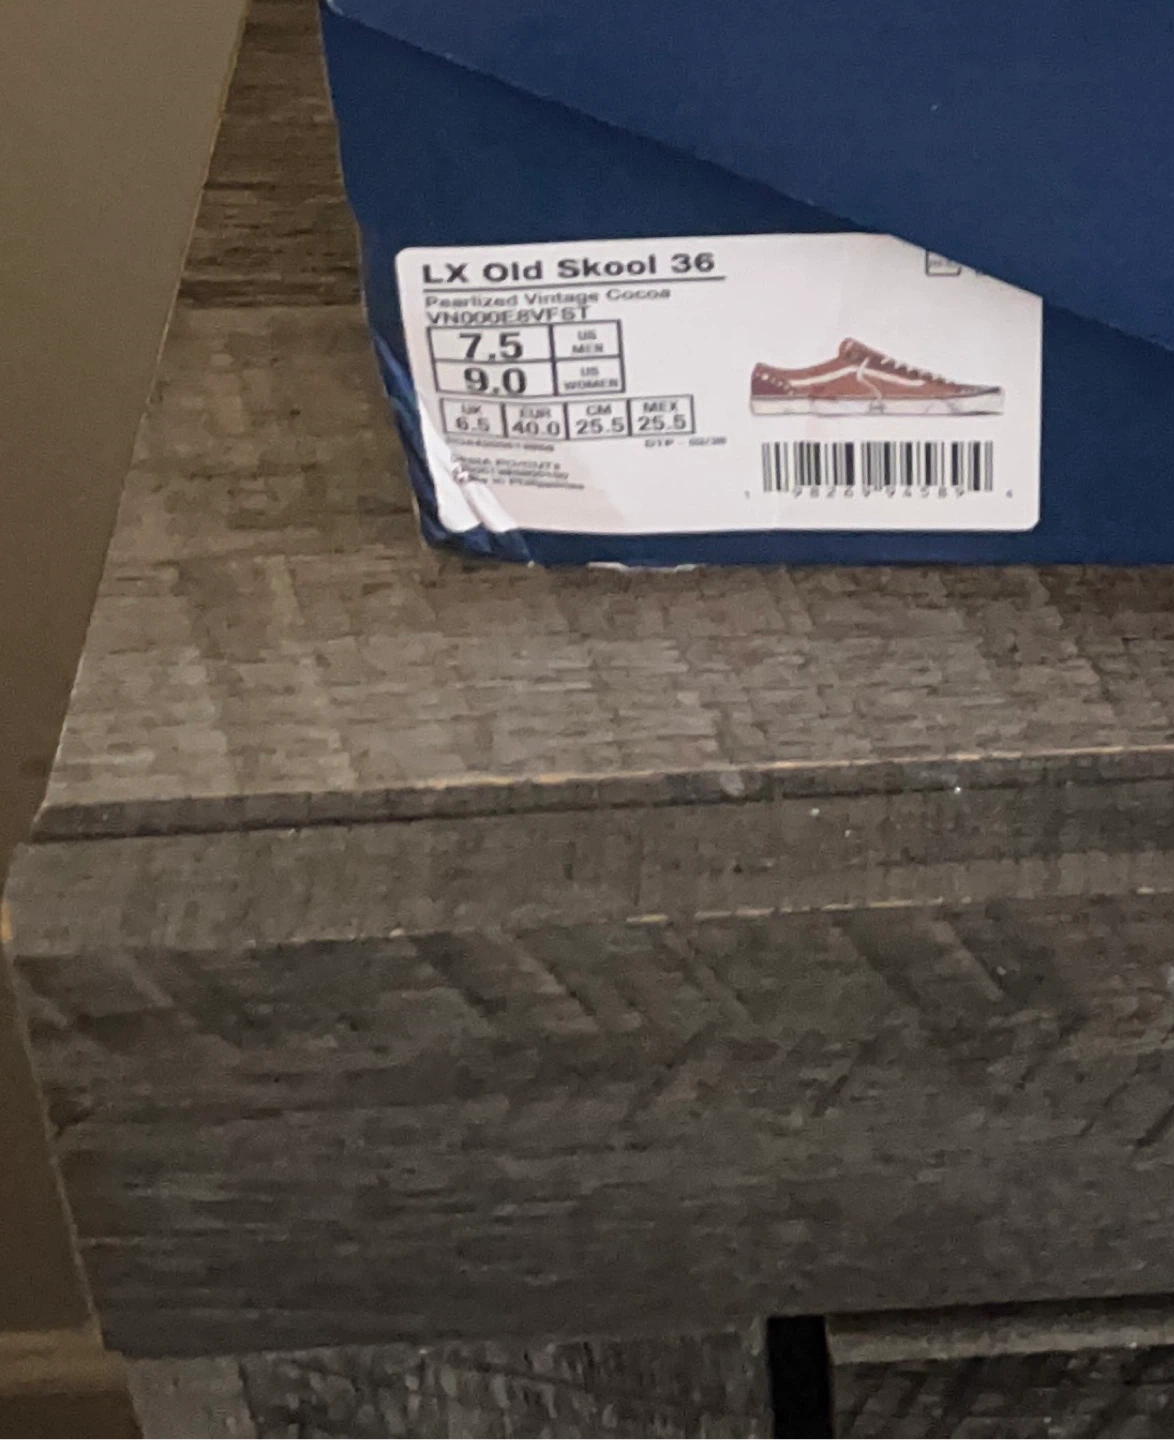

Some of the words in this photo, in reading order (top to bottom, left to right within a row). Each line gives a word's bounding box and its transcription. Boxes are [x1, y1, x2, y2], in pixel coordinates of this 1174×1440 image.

[422, 263, 469, 284] LX
[482, 260, 543, 282] Old
[557, 254, 656, 279] Skool
[671, 252, 715, 273] 36
[425, 294, 518, 309] Pearlized
[524, 290, 600, 306] Vintage
[605, 287, 671, 301] Cocoa
[458, 331, 524, 361] 7.5
[463, 366, 527, 395] 9.0
[586, 404, 612, 416] CM
[454, 416, 490, 432] 6.5
[511, 420, 560, 436] 40.0
[575, 417, 625, 434] 25.5
[637, 414, 687, 431] 25.5
